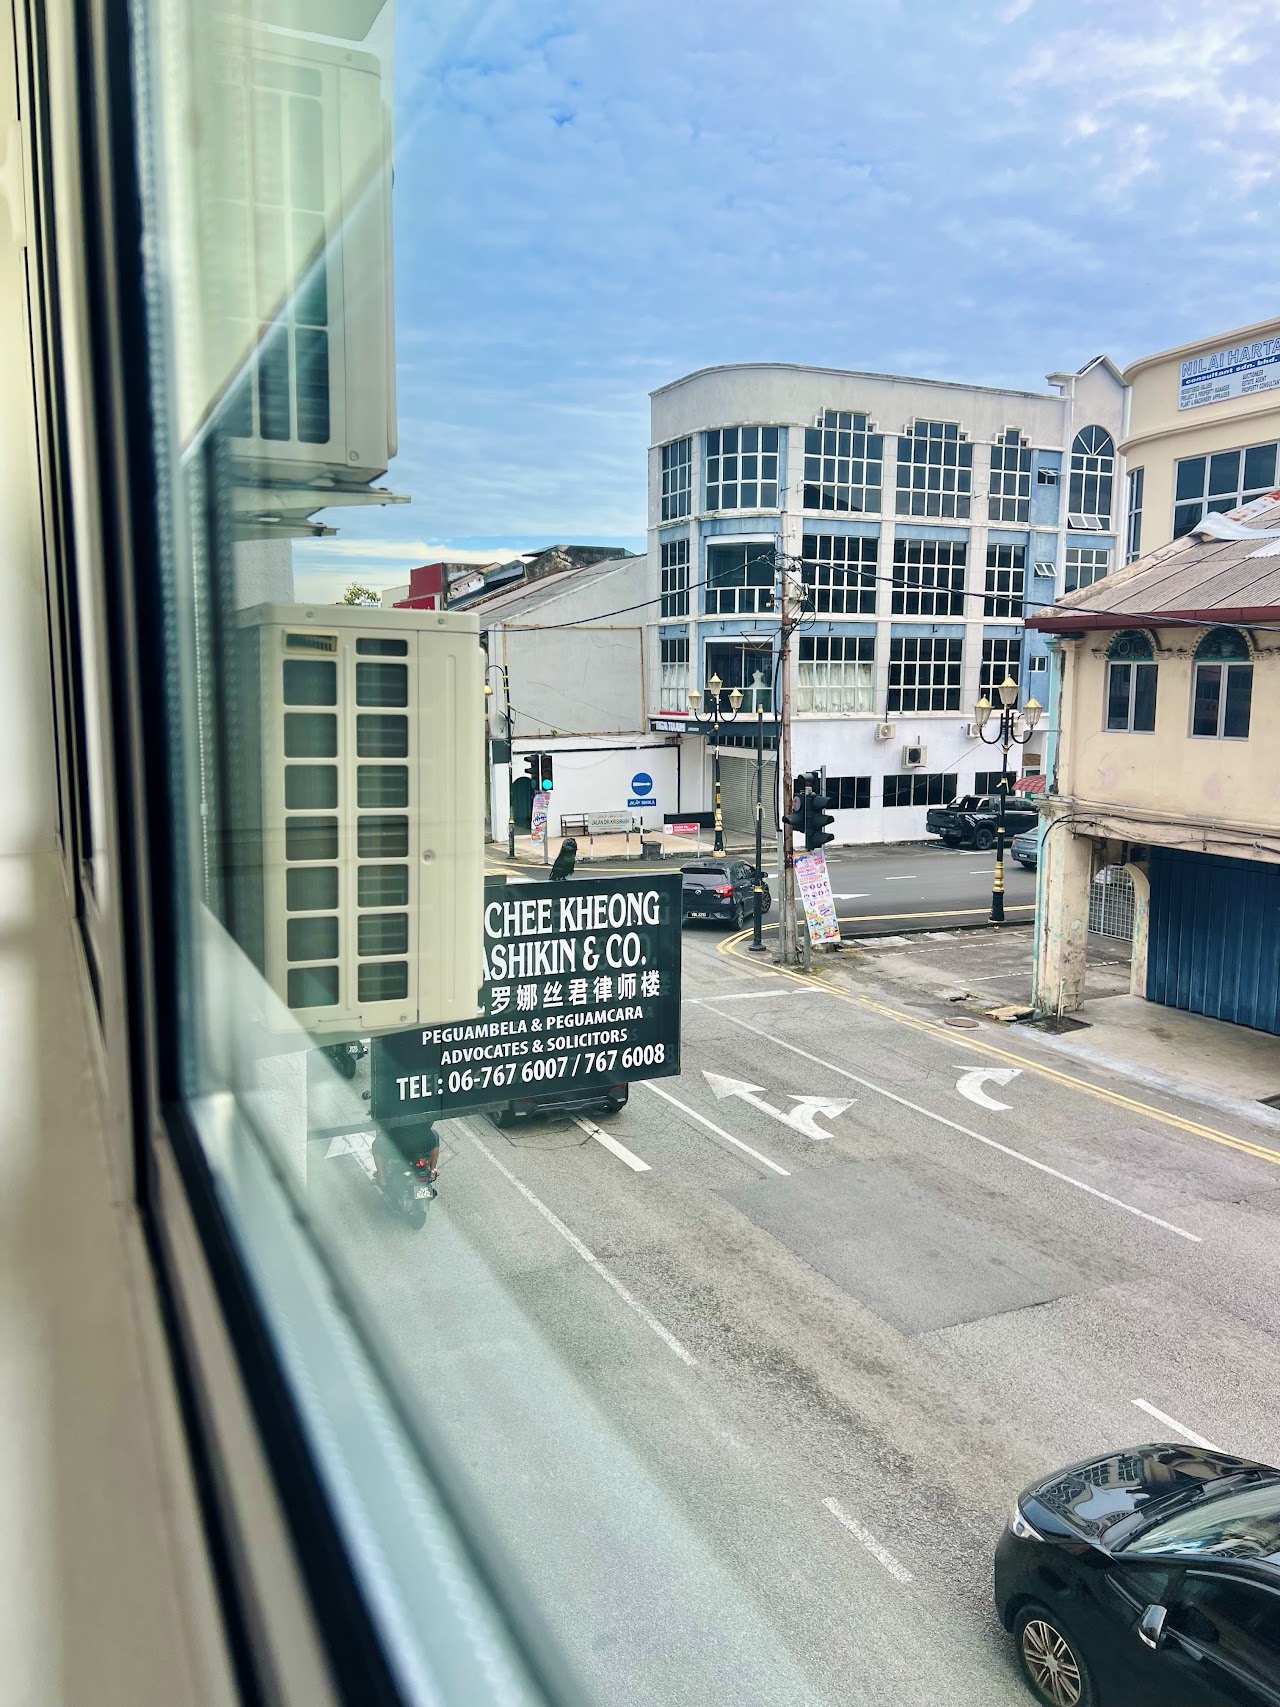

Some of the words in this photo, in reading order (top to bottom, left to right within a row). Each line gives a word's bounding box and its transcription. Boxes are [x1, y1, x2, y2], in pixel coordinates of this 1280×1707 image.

[1182, 352, 1225, 378] NILAI
[1227, 337, 1280, 366] HARTA
[1185, 368, 1233, 385] consultant
[1235, 363, 1256, 372] sdn.
[1257, 356, 1278, 367] bhd.
[1255, 375, 1267, 383] AGENT
[484, 898, 553, 938] CHEE
[559, 890, 660, 933] KHEONG
[582, 935, 600, 972] &
[606, 932, 647, 969] CO.
[481, 970, 660, 1016] 罗娜丝君律师楼
[422, 1019, 527, 1046] PEGUAMBELA
[531, 1018, 543, 1033] &
[546, 1006, 643, 1031] PEGUAMCARA
[440, 1041, 527, 1066] ADVOCATES
[532, 1041, 544, 1054] &
[547, 1028, 628, 1051] SOLICITORS
[396, 1074, 432, 1101] TEL
[448, 1059, 517, 1094] 06-767
[521, 1056, 569, 1083] 6007
[571, 1054, 581, 1077] /
[584, 1051, 617, 1074] 767
[621, 1043, 665, 1070] 6008
